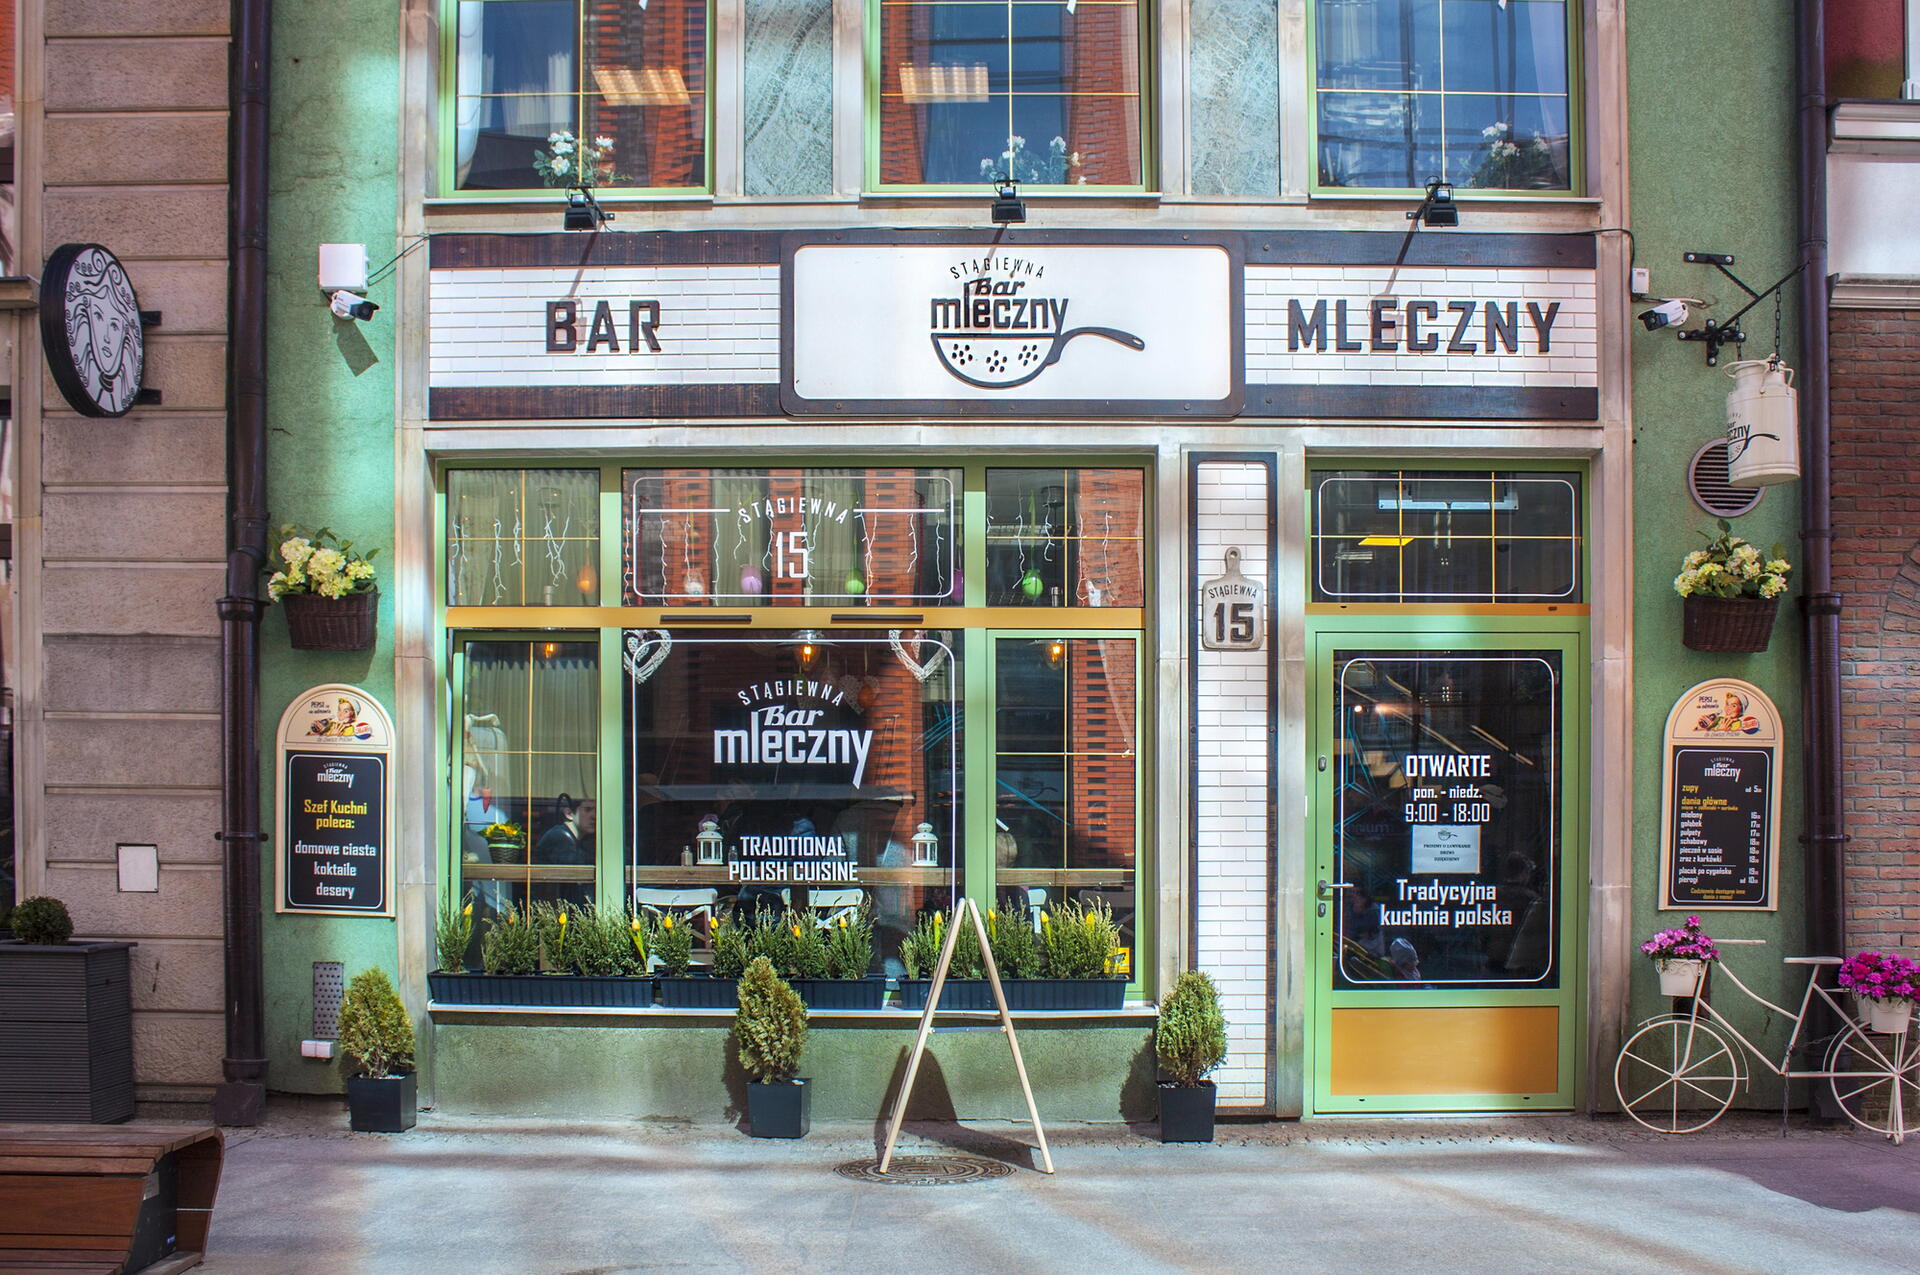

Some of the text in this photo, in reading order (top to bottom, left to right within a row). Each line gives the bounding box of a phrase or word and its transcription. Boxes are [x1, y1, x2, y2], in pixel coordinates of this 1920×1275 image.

[950, 257, 1045, 279] STĄGIEWNA
[968, 277, 1026, 297] Bar
[931, 282, 1069, 334] mleczny
[546, 300, 661, 353] BAR
[1288, 299, 1561, 355] MLECZNY
[738, 497, 848, 524] STĄGIEWNA
[776, 531, 809, 578] 15
[1208, 584, 1258, 599] STĄGIEWNA
[1213, 602, 1254, 643] 15
[737, 680, 844, 707] STĄGIEWNA
[757, 704, 825, 727] Bar
[713, 711, 874, 790] mleczny
[1405, 754, 1491, 777] OTWARTE
[1704, 764, 1742, 783] mleczny
[317, 768, 354, 789] mleczny
[1681, 785, 1699, 793] zupy
[1413, 787, 1438, 801] pon.
[1449, 784, 1483, 799] niedz.
[304, 799, 368, 815] Szef Kuchni
[1405, 803, 1438, 823] 9:00
[1453, 803, 1491, 823] 18:00
[316, 814, 355, 831] poleca:
[295, 840, 377, 857] domowe ciasta
[740, 836, 847, 857] TRADITIONAL
[314, 861, 357, 877] koktaile
[729, 861, 858, 881] POLISH CUISINE
[316, 882, 355, 900] desery
[1396, 878, 1497, 906] Tradycyjna
[1379, 903, 1512, 928] kuchnia polska
